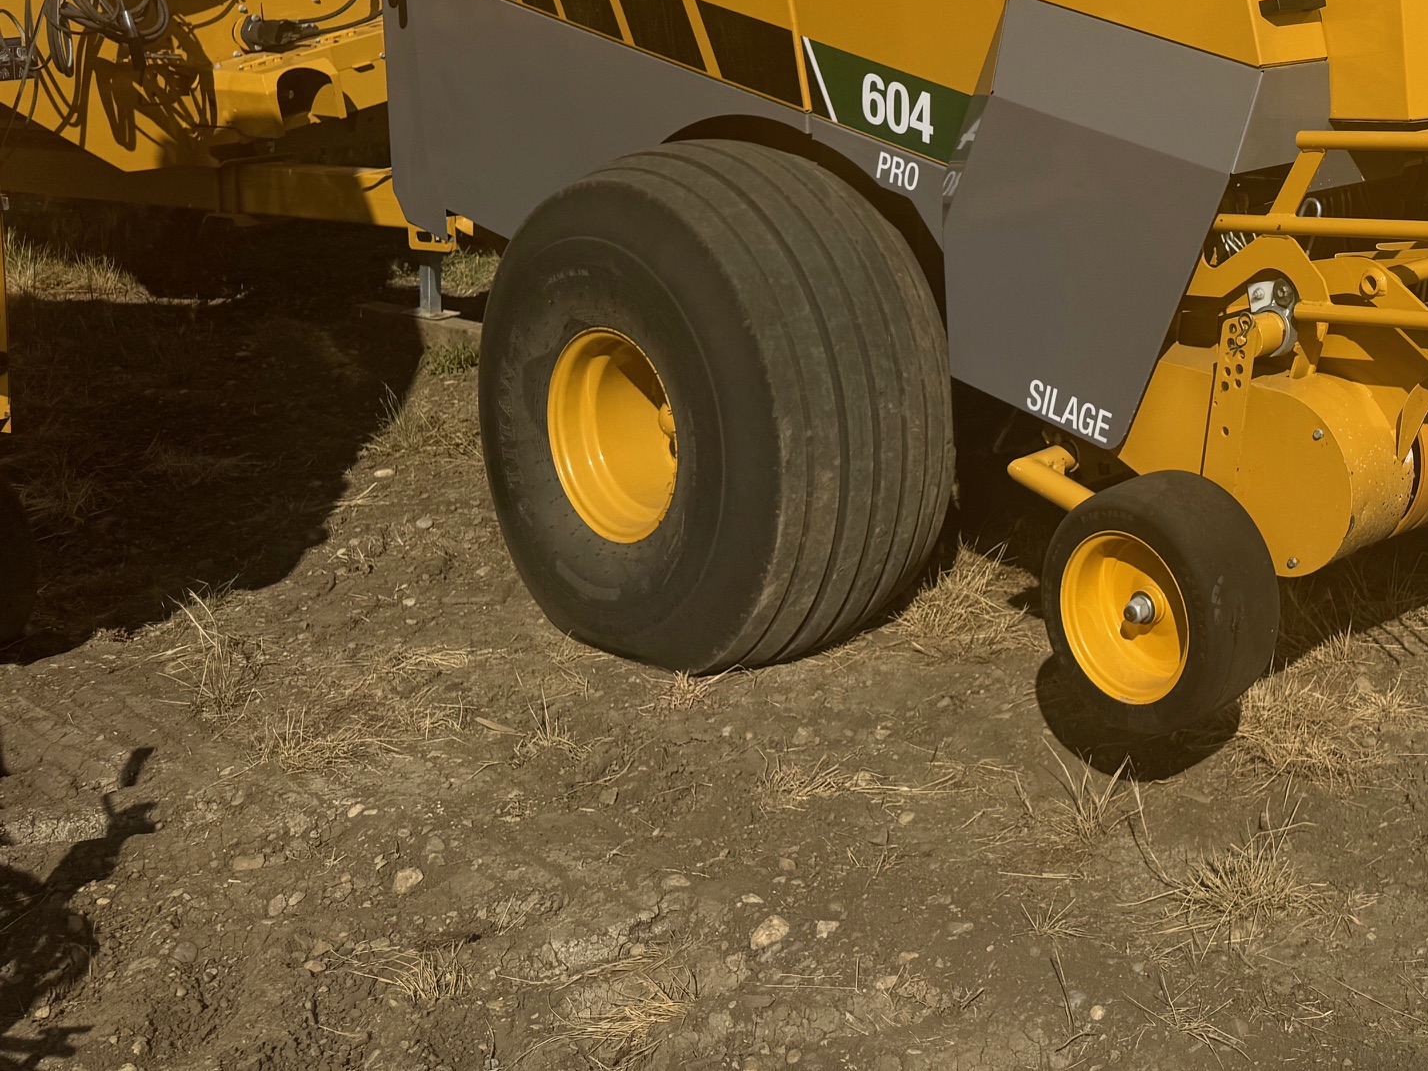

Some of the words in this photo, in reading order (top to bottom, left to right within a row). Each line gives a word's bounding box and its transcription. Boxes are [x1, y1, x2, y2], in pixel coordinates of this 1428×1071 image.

[862, 72, 934, 144] 604
[876, 150, 919, 191] PRO
[1026, 379, 1112, 443] SILAGE
